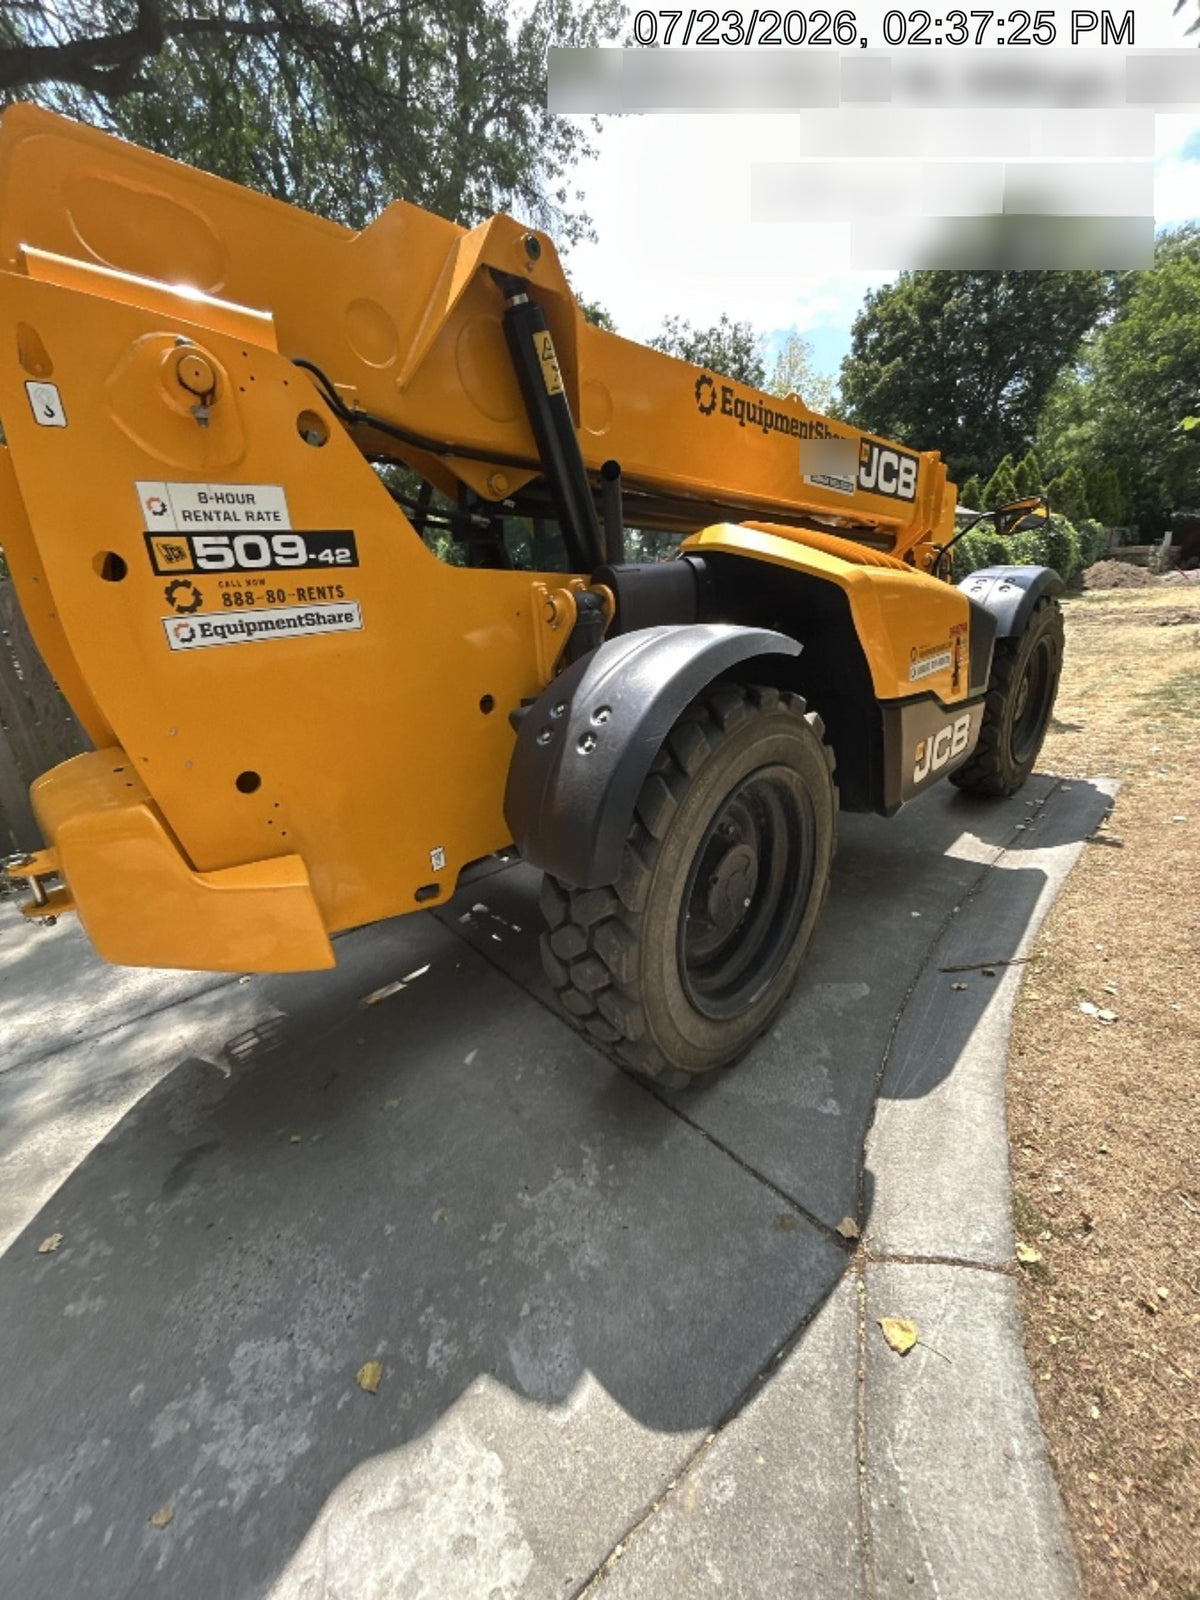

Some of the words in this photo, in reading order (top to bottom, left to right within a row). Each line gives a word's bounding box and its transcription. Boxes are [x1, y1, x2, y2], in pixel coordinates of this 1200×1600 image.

[859, 447, 918, 499] JCB
[181, 510, 241, 522] RENTAL
[244, 510, 282, 522] RATE
[192, 534, 352, 570] 509-42
[198, 611, 354, 639] EquipmentShare
[913, 713, 971, 784] JCB
